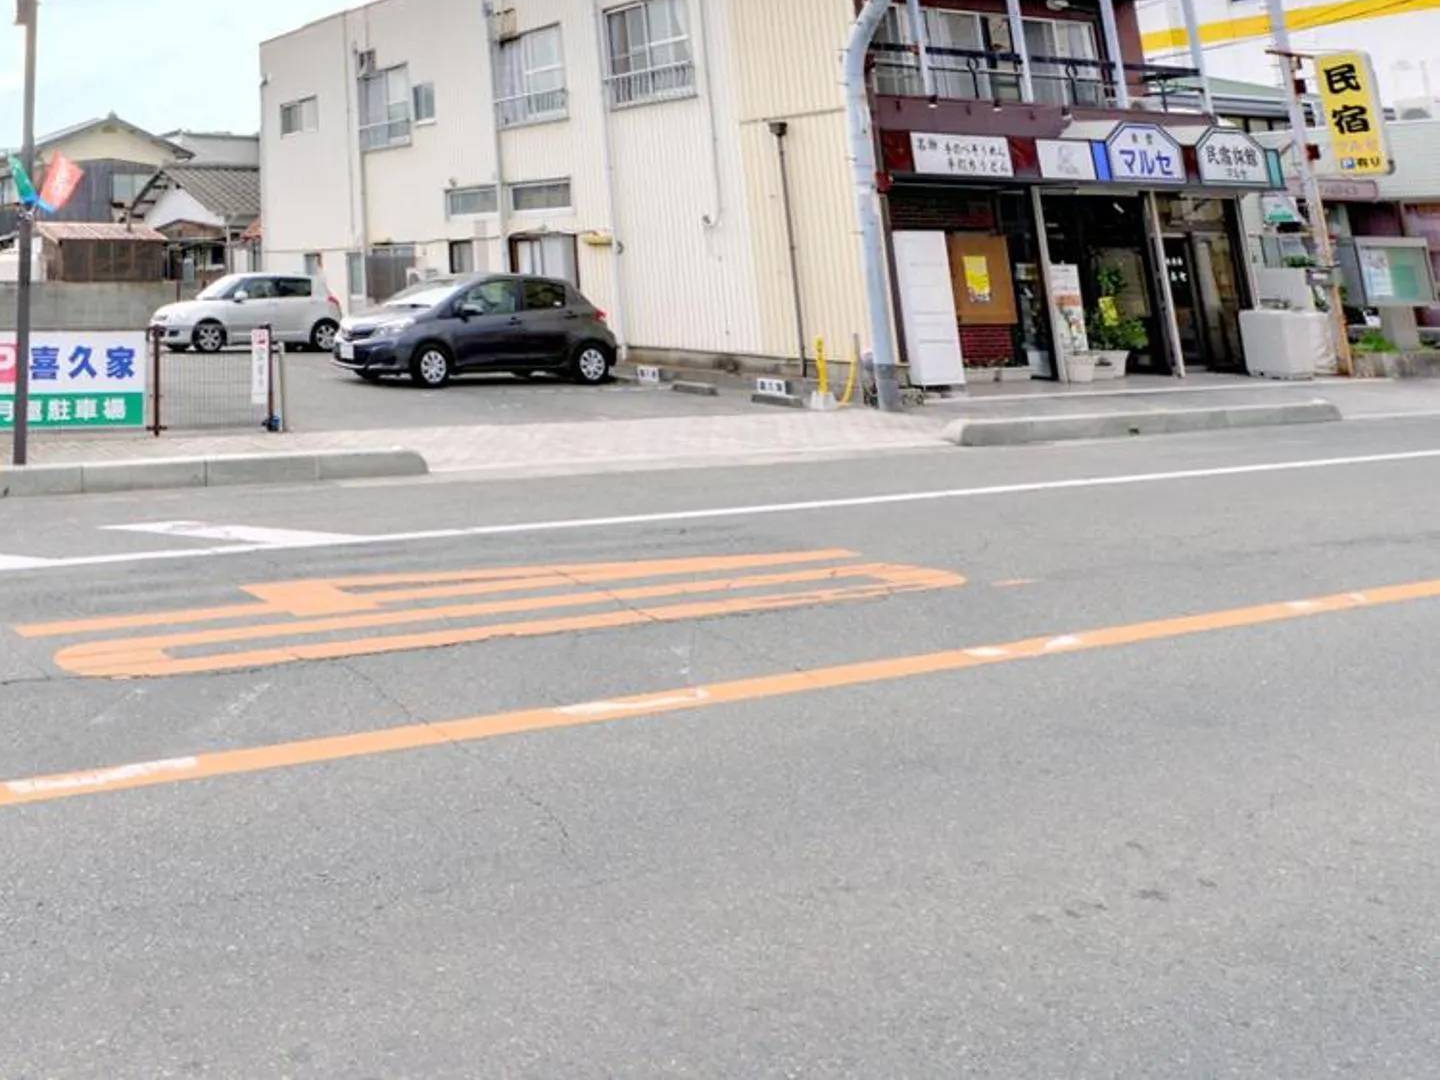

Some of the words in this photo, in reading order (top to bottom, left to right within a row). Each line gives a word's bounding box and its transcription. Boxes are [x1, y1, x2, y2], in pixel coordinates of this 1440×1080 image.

[1324, 63, 1370, 134] 民宿
[1119, 149, 1173, 176] マルセ
[29, 346, 135, 380] 喜久家
